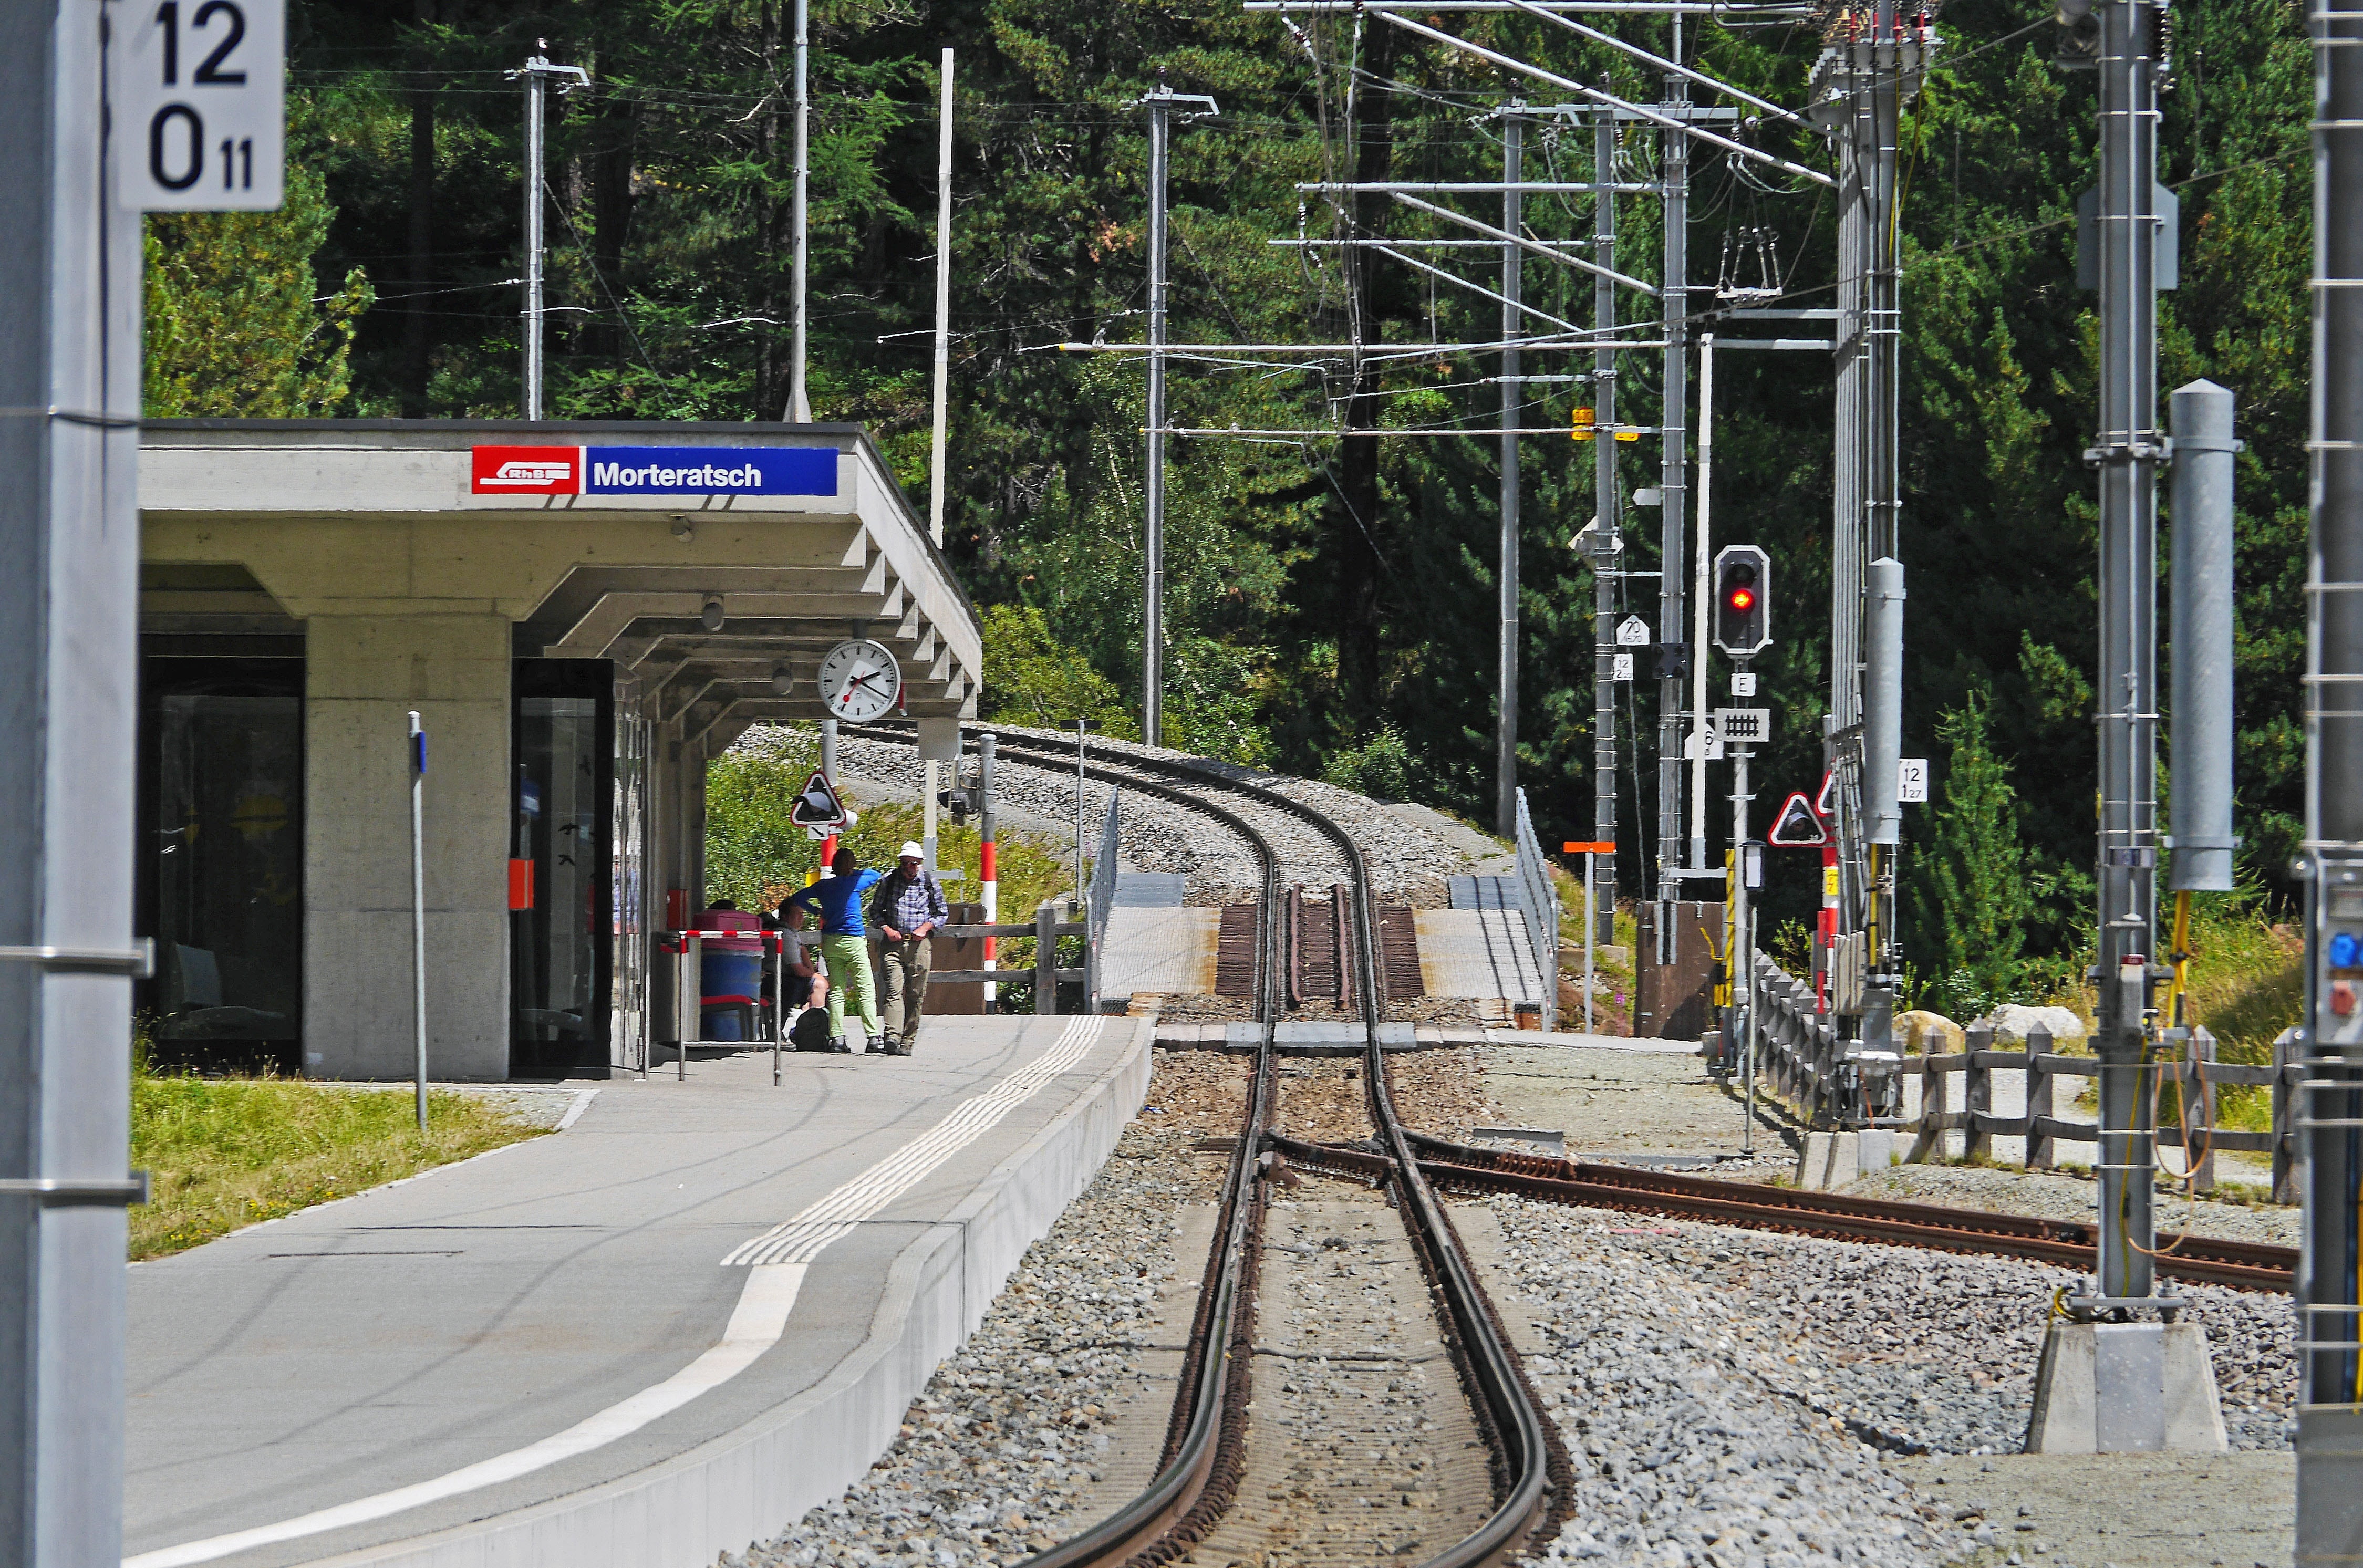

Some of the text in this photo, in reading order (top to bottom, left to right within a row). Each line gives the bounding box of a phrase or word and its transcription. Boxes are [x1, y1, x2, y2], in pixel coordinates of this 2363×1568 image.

[156, 1, 246, 86] 12
[149, 102, 252, 191] 0 11
[509, 469, 544, 479] RhB
[594, 462, 761, 487] Morteratsch
[1626, 621, 1640, 633] 70
[1739, 677, 1747, 692] E
[1905, 767, 1920, 782] 12
[1903, 784, 1922, 798] 1 27
